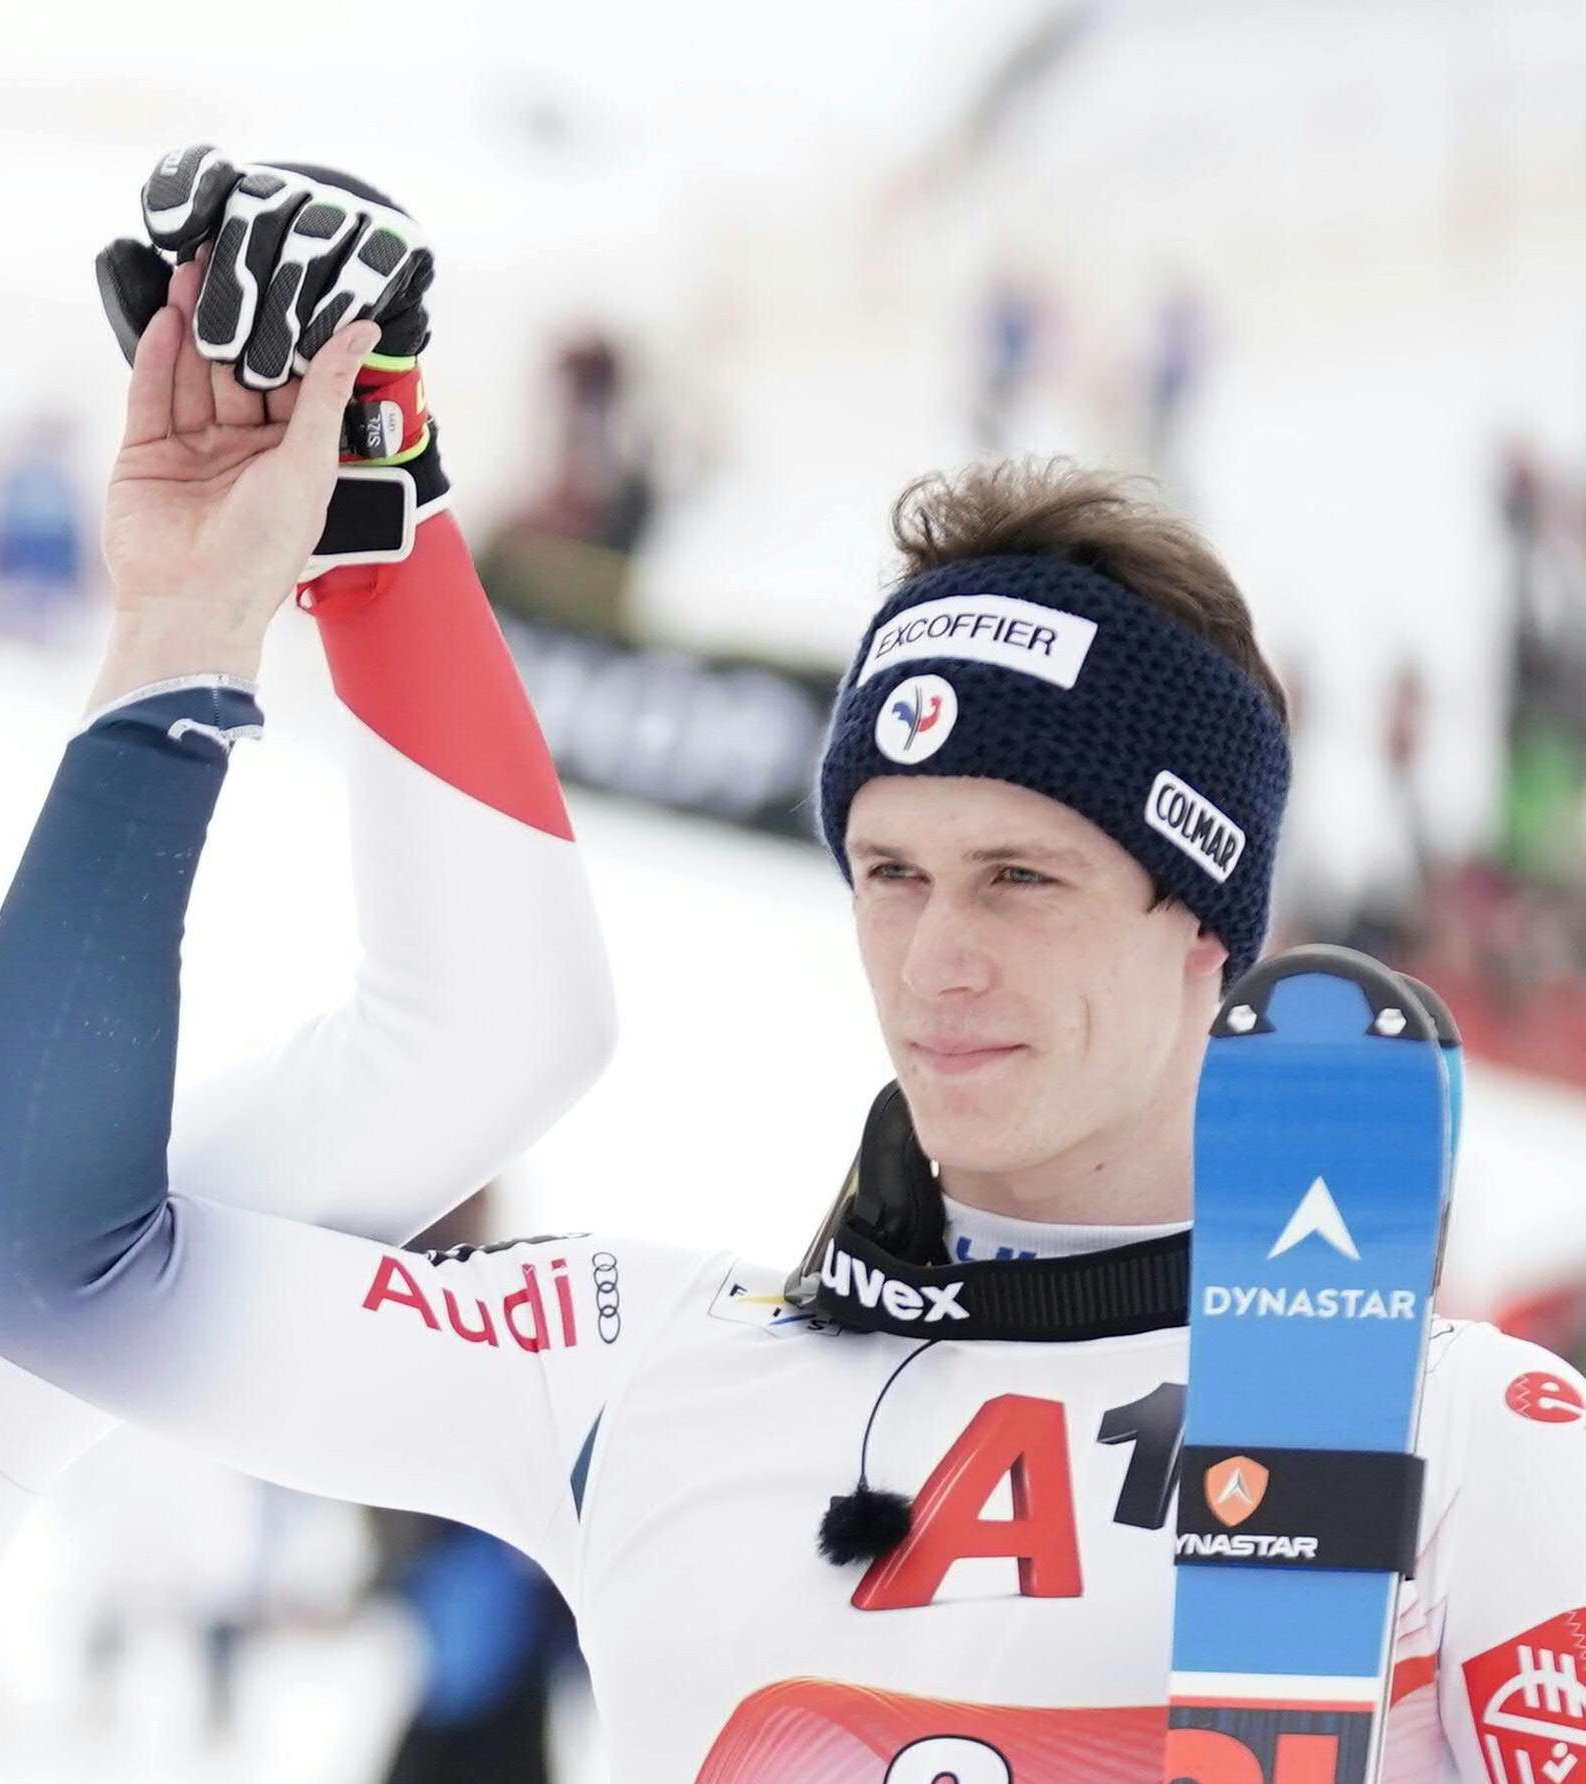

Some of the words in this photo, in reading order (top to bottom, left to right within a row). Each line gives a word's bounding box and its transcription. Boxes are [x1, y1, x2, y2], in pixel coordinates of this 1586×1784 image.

[875, 612, 1058, 661] EXCOFFIER
[1156, 783, 1239, 874] COLMAR
[361, 1254, 578, 1354] Audi
[821, 1239, 971, 1323] uvex
[1203, 1285, 1417, 1320] DYNASTAR
